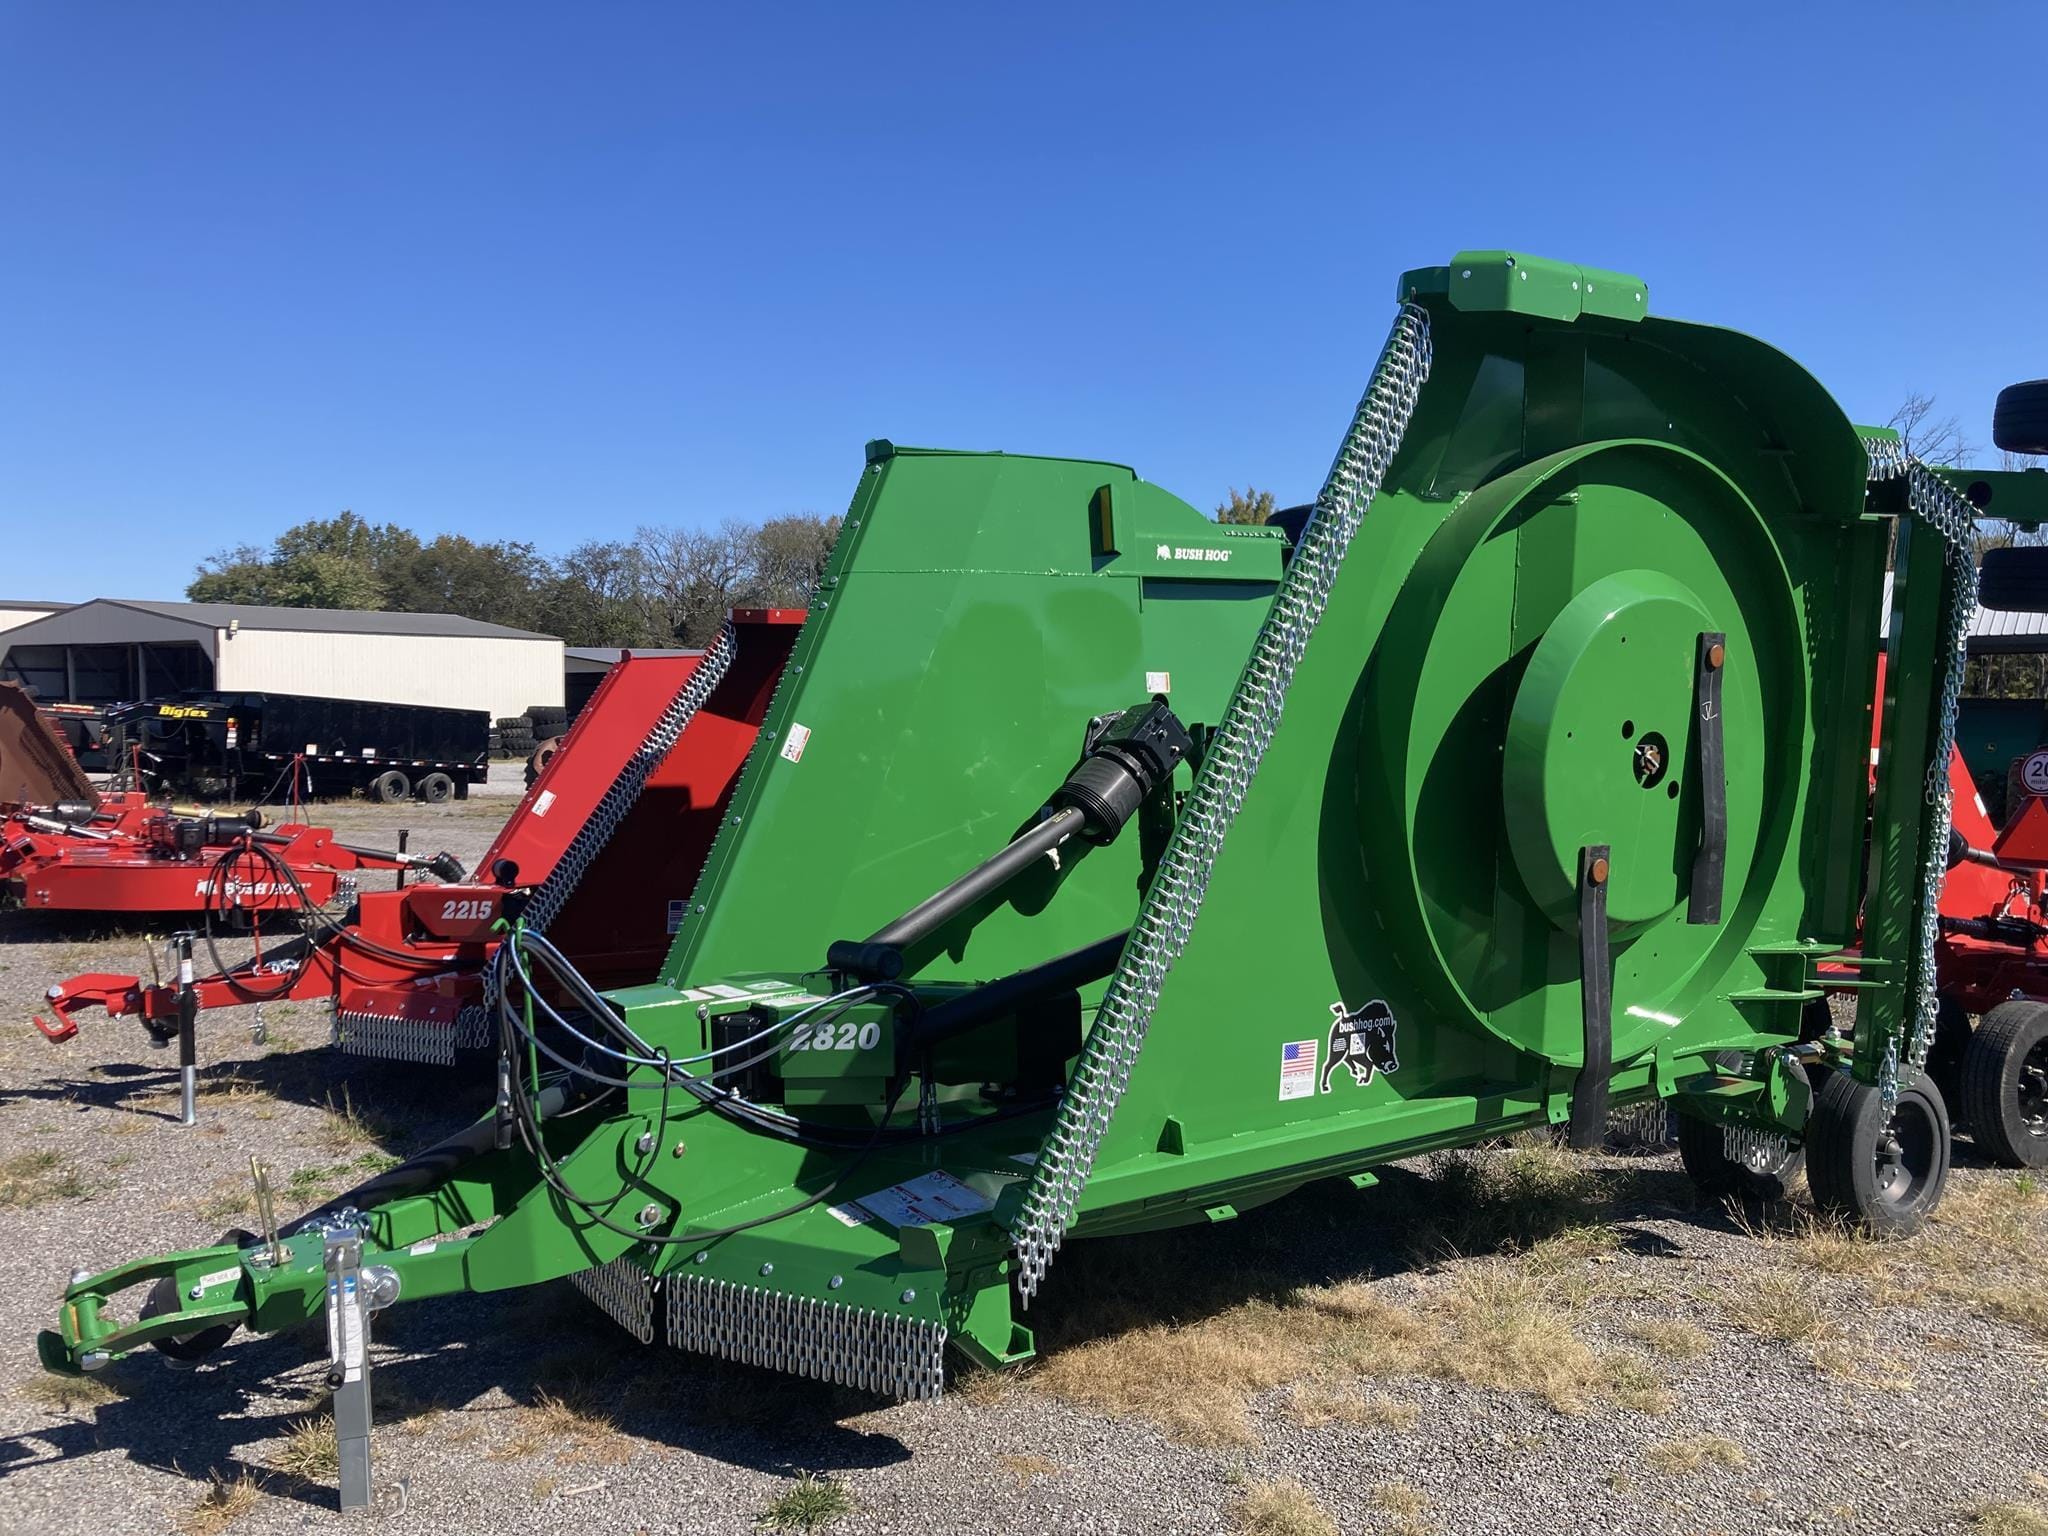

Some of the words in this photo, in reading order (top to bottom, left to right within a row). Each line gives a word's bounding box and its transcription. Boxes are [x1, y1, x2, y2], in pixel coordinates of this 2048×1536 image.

[1174, 548, 1203, 560] BUSH
[159, 705, 209, 718] BigTex
[441, 900, 493, 920] 2215
[1339, 1017, 1391, 1033] bushhog.com
[789, 1022, 881, 1051] 2820
